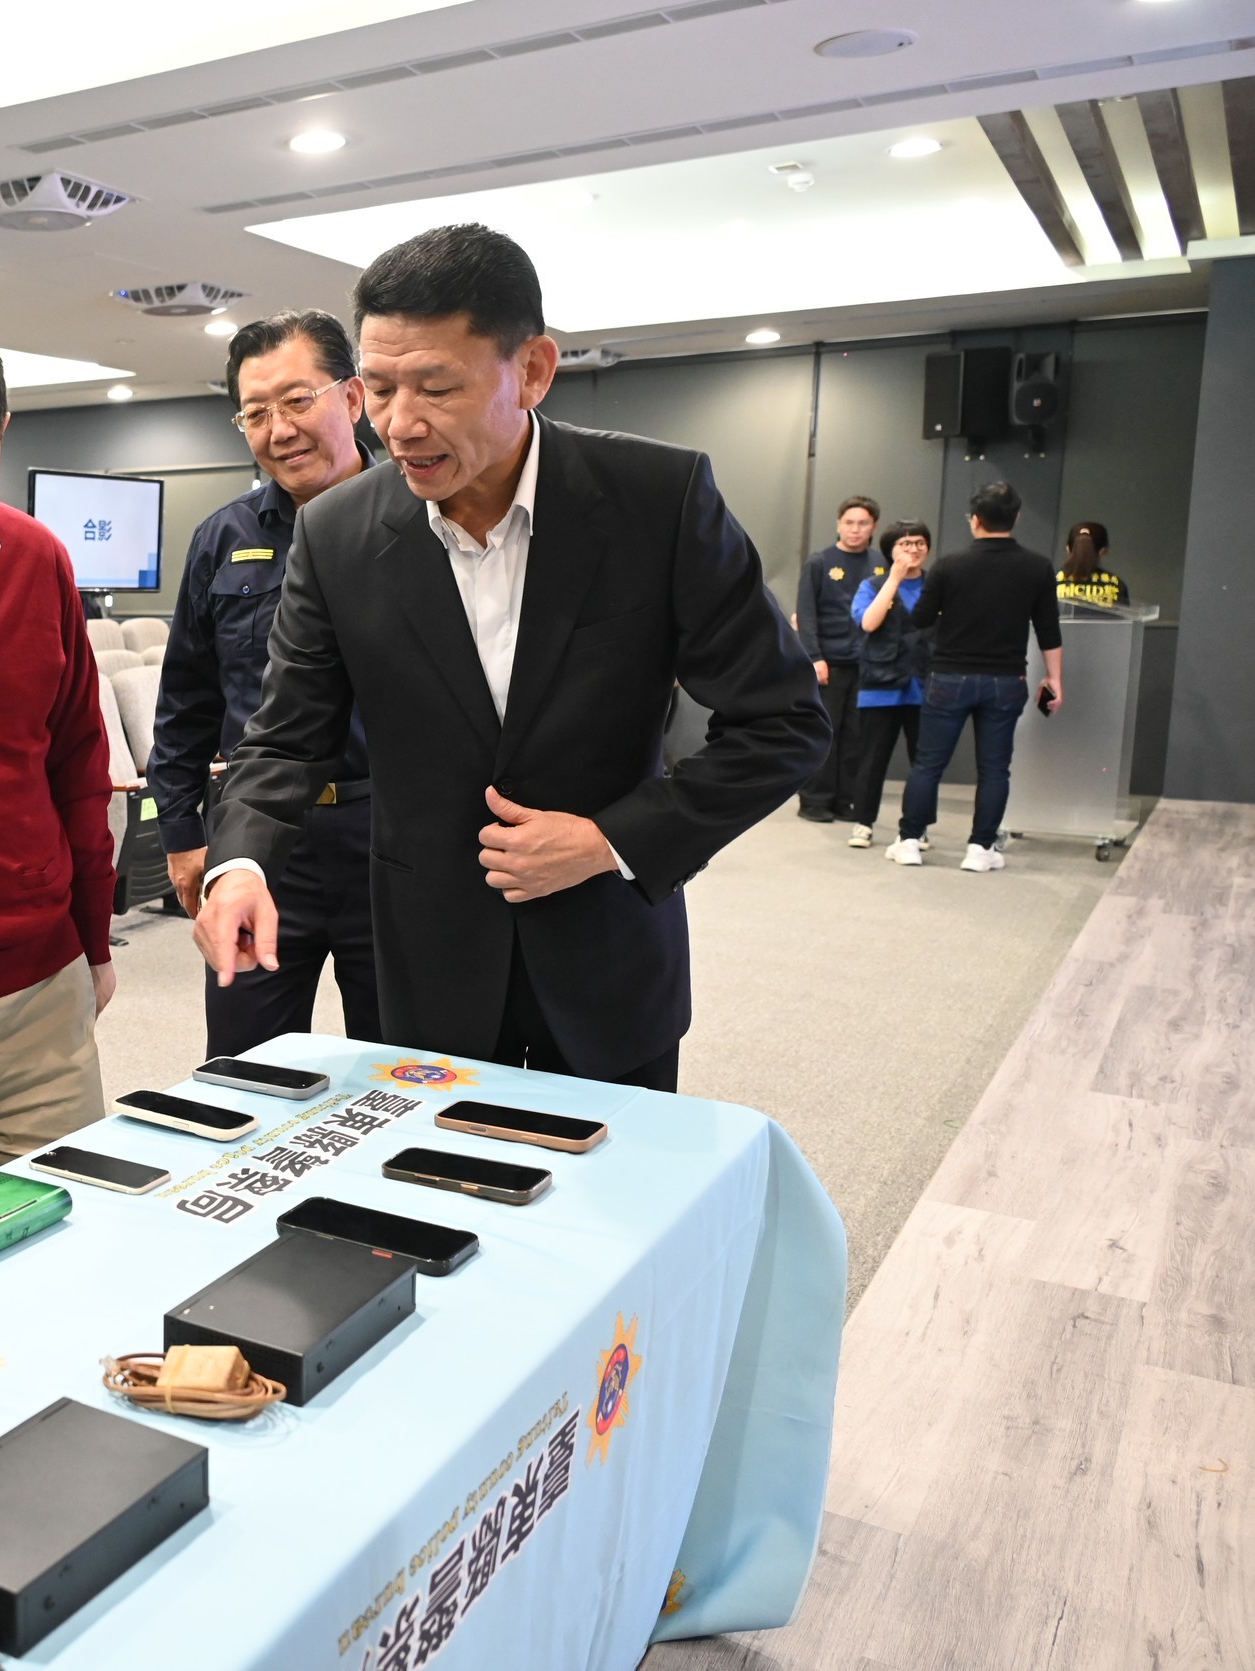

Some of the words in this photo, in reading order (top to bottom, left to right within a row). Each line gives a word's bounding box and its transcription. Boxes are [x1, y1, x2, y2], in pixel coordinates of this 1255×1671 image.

[83, 518, 113, 541] 合影
[176, 1089, 423, 1224] 臺東縣警察局
[362, 1407, 580, 1671] 臺東縣警察
